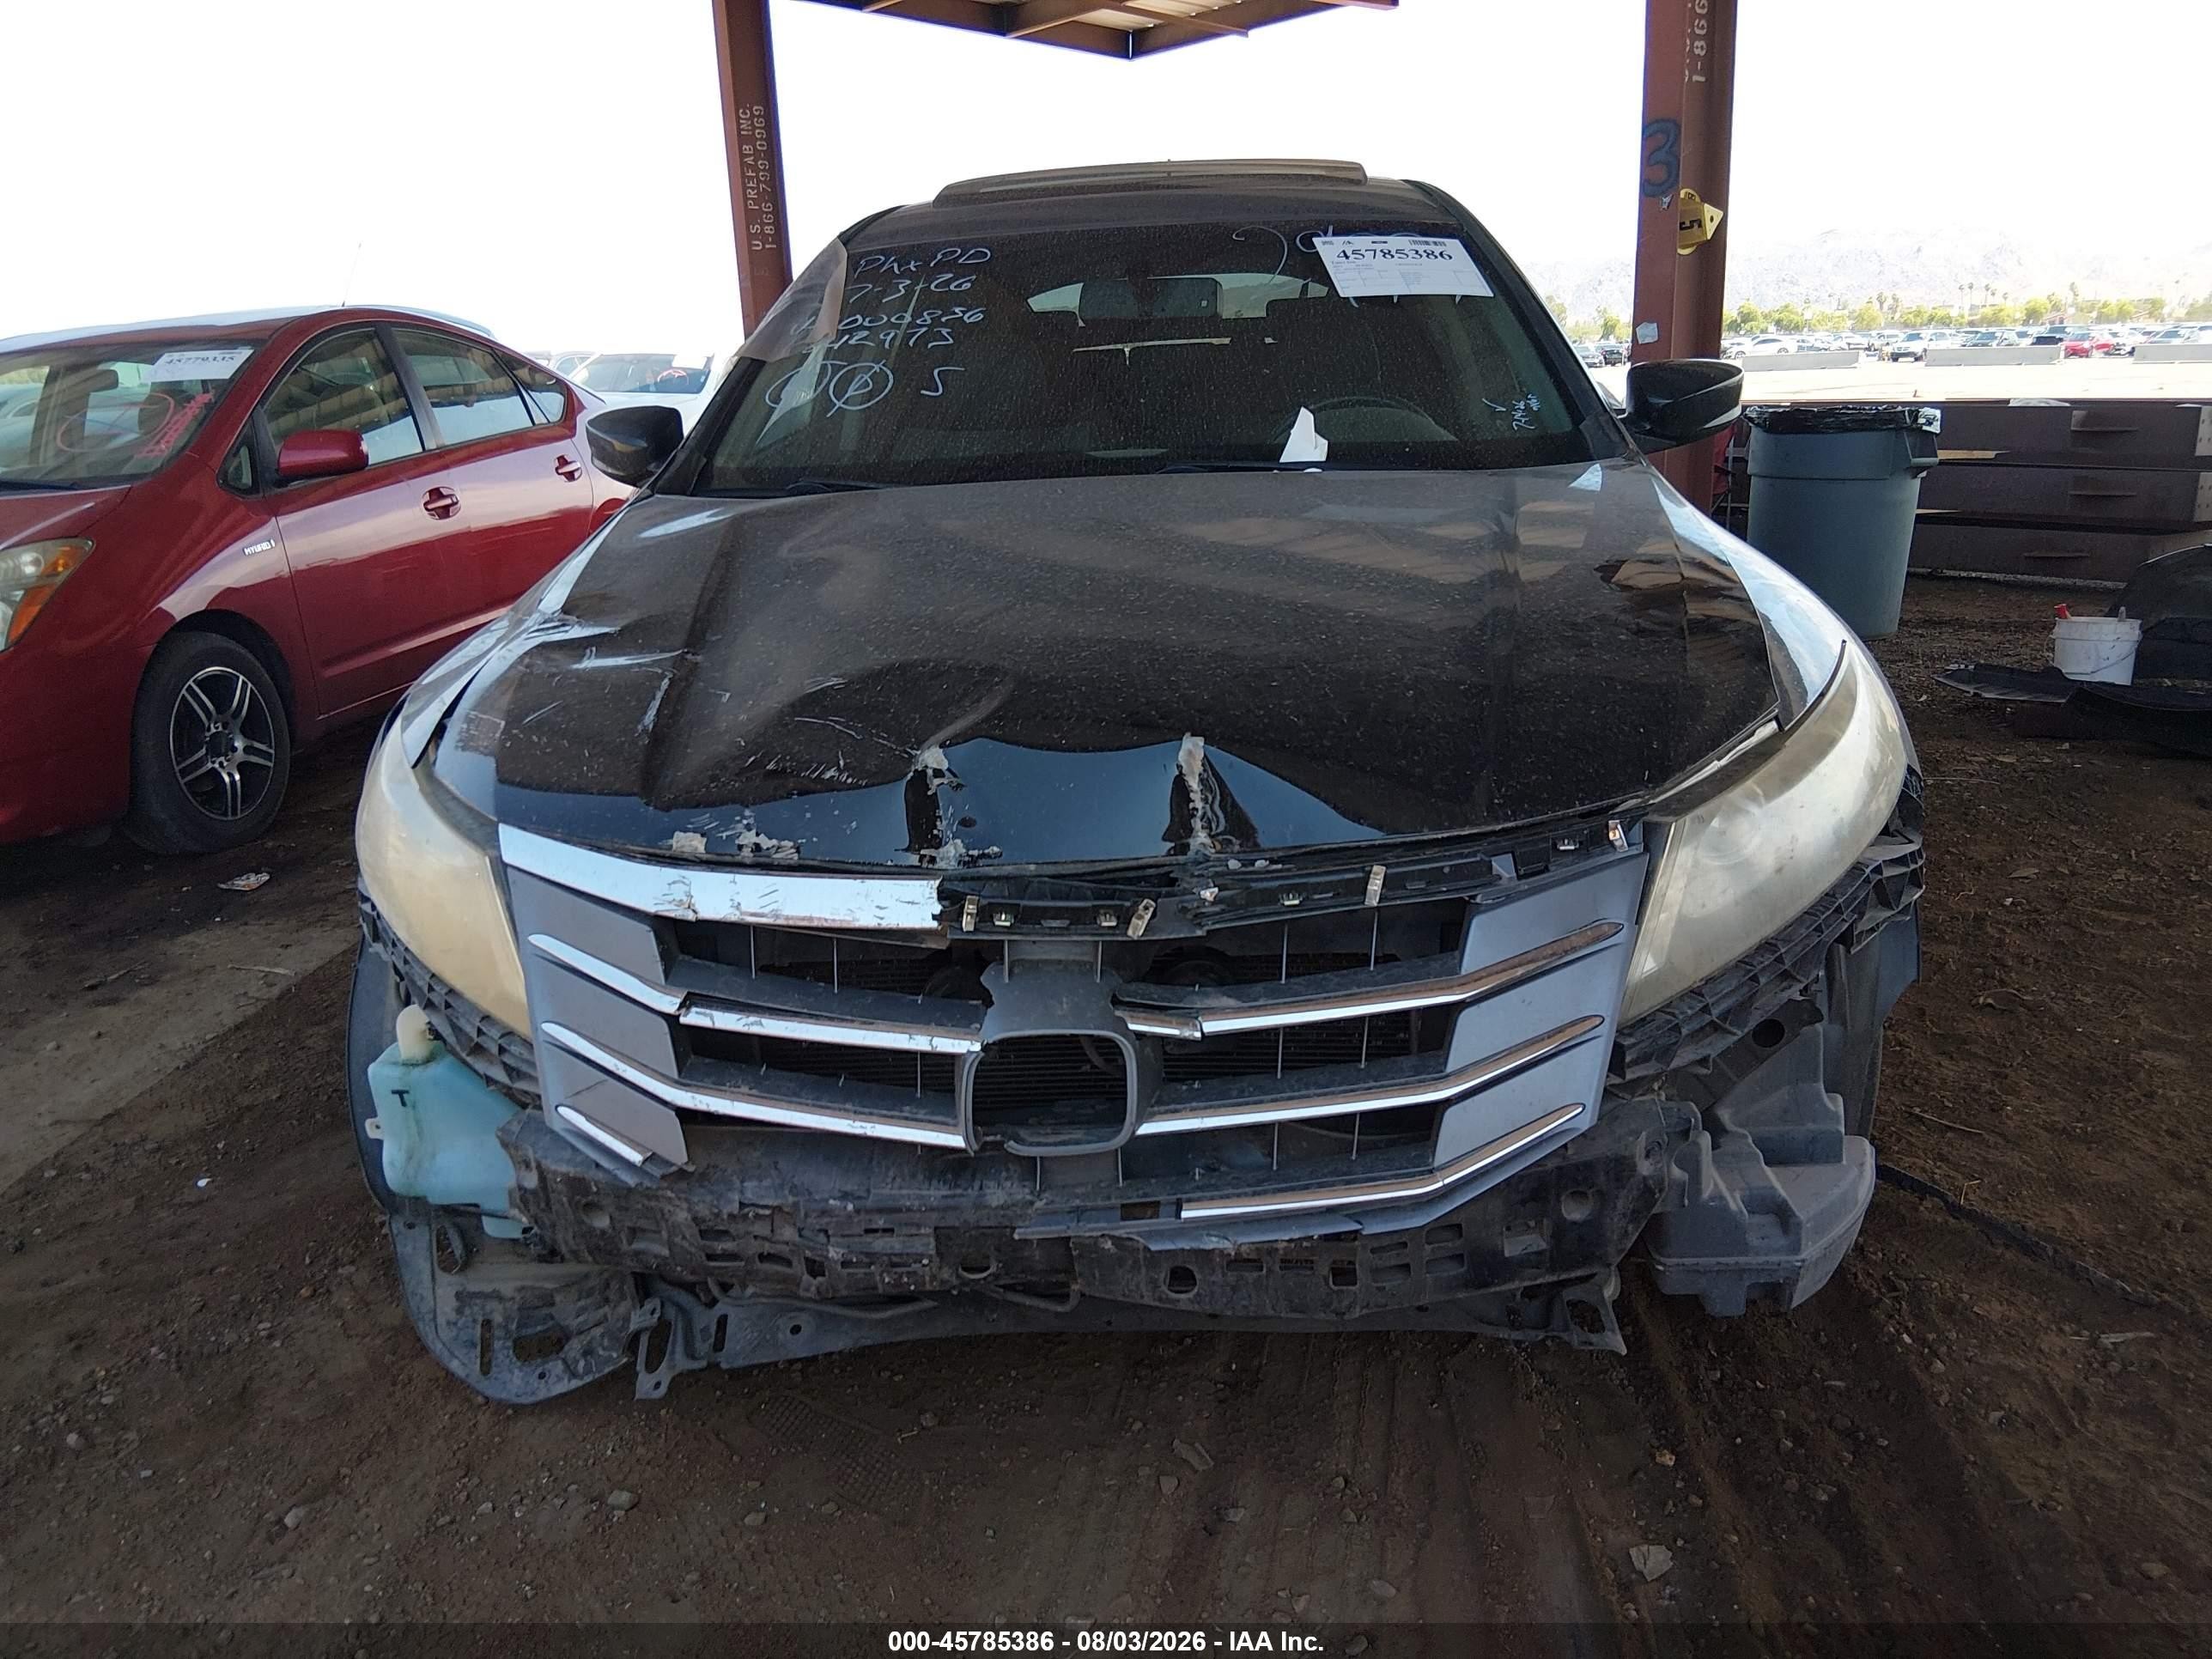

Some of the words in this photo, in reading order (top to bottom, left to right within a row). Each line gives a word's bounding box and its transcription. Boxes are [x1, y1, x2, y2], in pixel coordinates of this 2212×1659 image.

[738, 104, 753, 136] INC.
[1642, 118, 1680, 198] 3
[742, 144, 760, 210] PREFAB
[752, 105, 777, 249] 1-866-799-0969
[750, 219, 763, 251] U.S.
[930, 247, 992, 268] PD
[1336, 246, 1453, 260] 45785386
[392, 1090, 410, 1108] T
